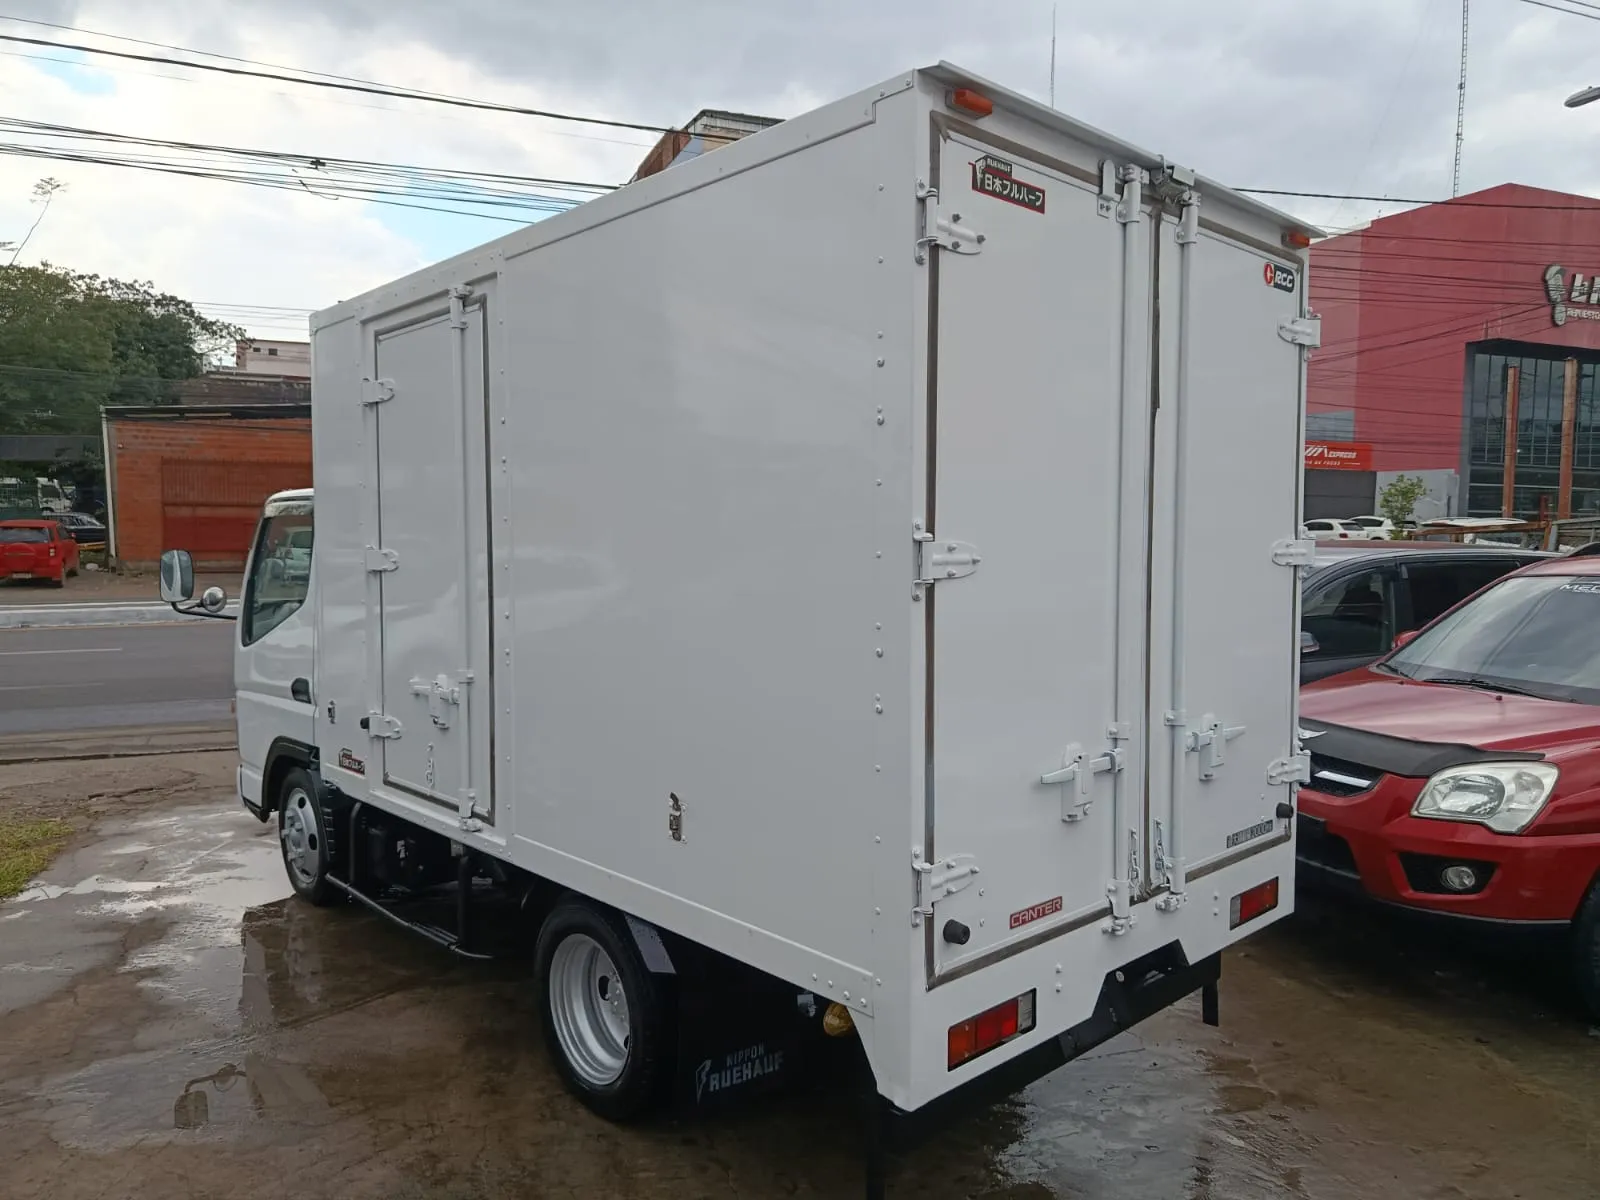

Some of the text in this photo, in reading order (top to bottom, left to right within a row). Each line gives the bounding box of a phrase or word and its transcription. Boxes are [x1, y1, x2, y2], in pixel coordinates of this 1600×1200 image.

[984, 172, 1043, 207] 日本フルハーフ
[1011, 898, 1061, 927] CANTER
[726, 1042, 764, 1067] NIPPON
